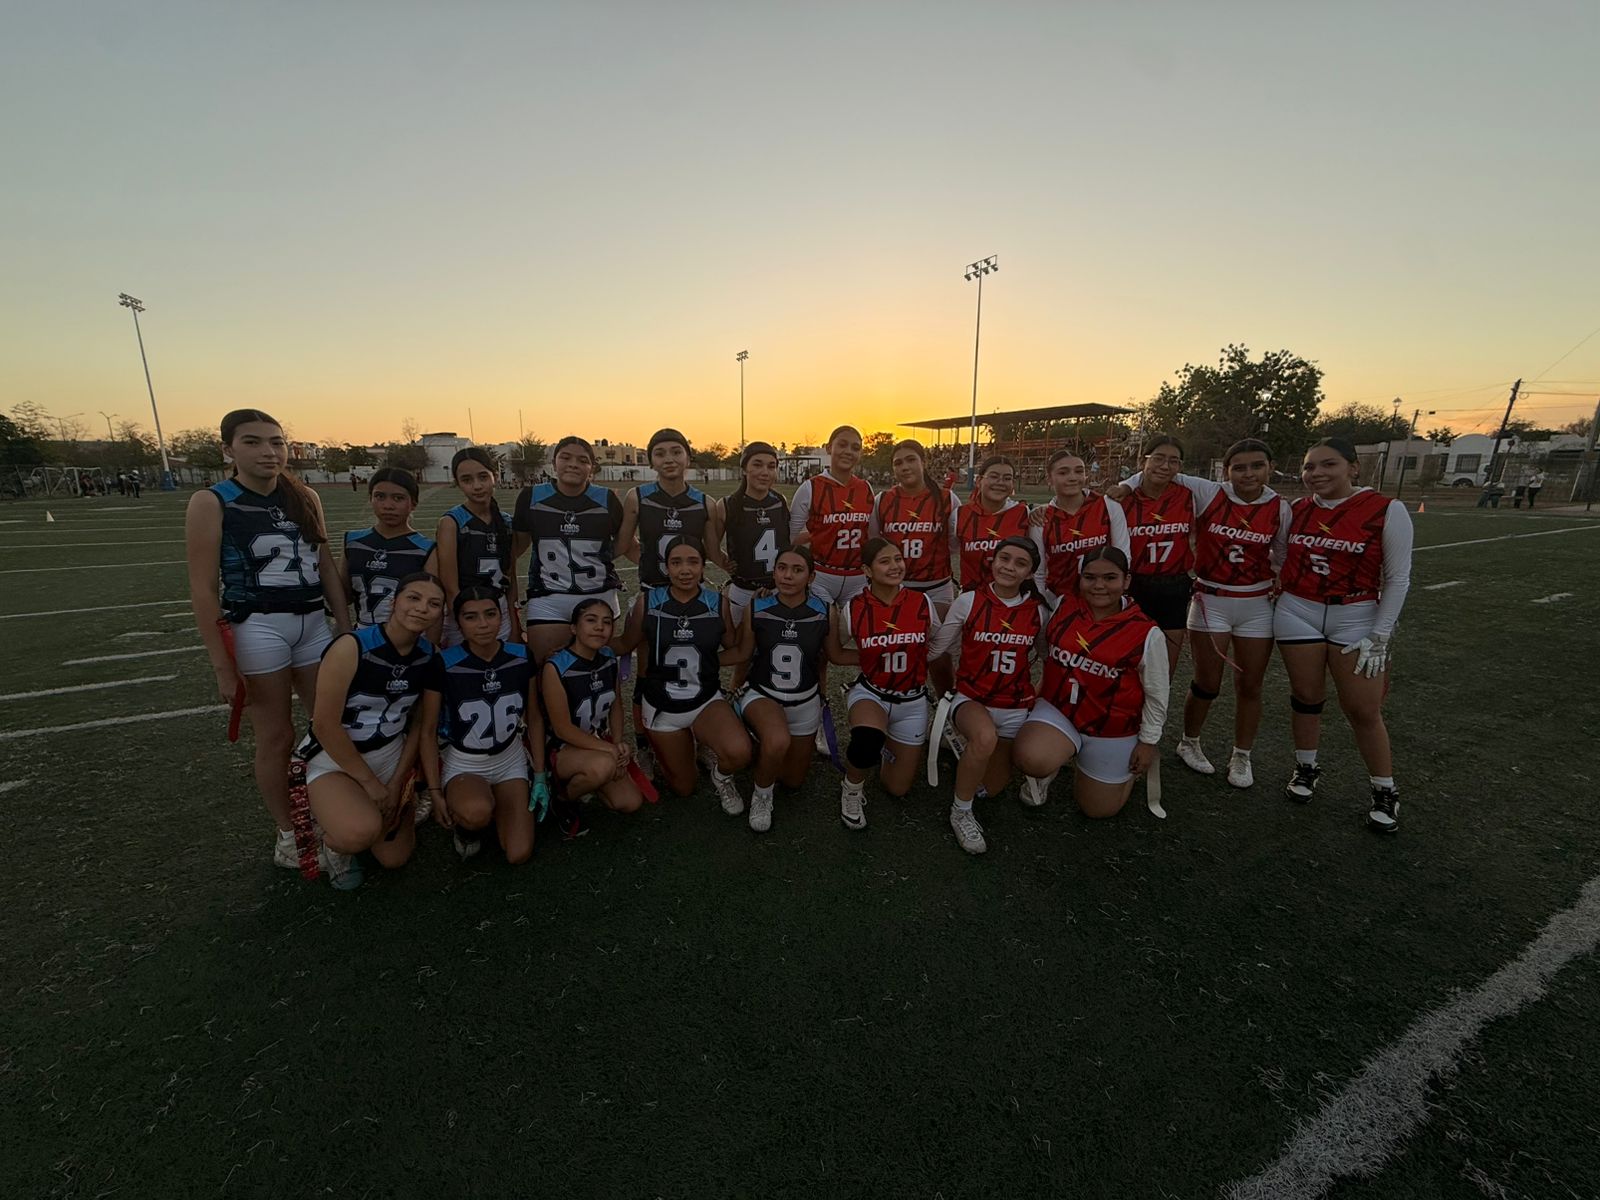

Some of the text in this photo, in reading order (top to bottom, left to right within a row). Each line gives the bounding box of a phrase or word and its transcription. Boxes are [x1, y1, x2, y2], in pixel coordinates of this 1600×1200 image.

[559, 524, 580, 533] LOBOS
[663, 518, 683, 529] LOBOS
[1128, 522, 1190, 538] MCQUEENS
[1208, 522, 1273, 544] MCQUEENS
[836, 528, 862, 550] 22
[901, 538, 924, 559] 18
[1050, 533, 1107, 554] MCQUEENS
[1288, 533, 1367, 554] MCQUEENS
[754, 529, 779, 572] 4
[1146, 541, 1175, 563] 17
[1229, 544, 1245, 563] 2
[537, 538, 607, 592] 85
[1310, 553, 1331, 576] 5
[351, 575, 400, 624] 12
[673, 629, 694, 639] LOBOS
[781, 629, 798, 639] LOBOS
[861, 632, 926, 649] MCQUEENS
[974, 631, 1035, 646] MCQUEENS
[770, 643, 802, 691] 9
[881, 651, 908, 673] 10
[990, 650, 1017, 675] 15
[664, 646, 703, 700] 3
[385, 679, 409, 691] LOBOS
[482, 681, 502, 692] LOBOS
[1069, 677, 1080, 705] 1
[458, 692, 524, 749] 26
